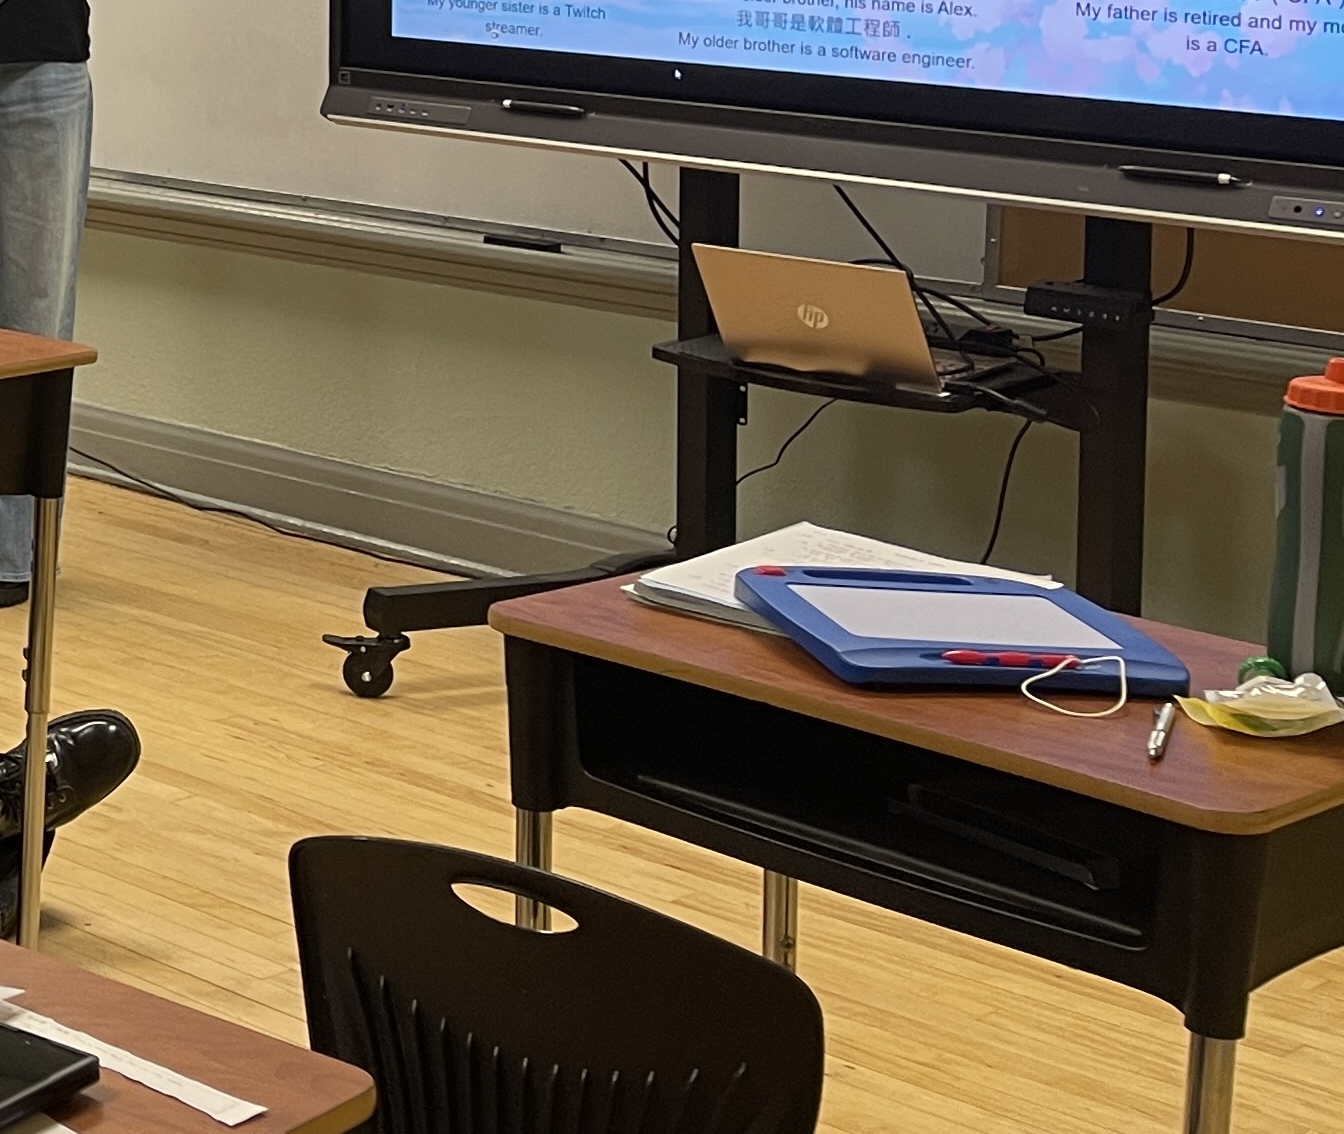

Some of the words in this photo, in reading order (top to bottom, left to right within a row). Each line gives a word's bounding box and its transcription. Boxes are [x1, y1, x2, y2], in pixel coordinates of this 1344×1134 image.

[501, 0, 535, 14] sister
[538, 1, 550, 15] is
[552, 6, 561, 16] a
[565, 3, 607, 20] Twitch
[920, 0, 934, 14] is
[937, 1, 978, 18] Alex.
[1075, 2, 1102, 20] My
[1107, 3, 1159, 22] father
[1163, 7, 1178, 23] is
[1184, 10, 1242, 28] retired
[1247, 14, 1283, 30] and
[1289, 18, 1317, 35] my
[485, 21, 543, 37] streamer.
[678, 31, 699, 49] My
[703, 34, 738, 50] older
[743, 37, 796, 55] brother
[800, 41, 813, 56] is
[817, 44, 827, 57] a
[831, 45, 897, 63] software
[902, 52, 976, 70] engineer.
[1186, 35, 1201, 51] is
[1206, 39, 1218, 52] a
[1223, 38, 1269, 56] CFA.
[797, 304, 829, 329] hp
